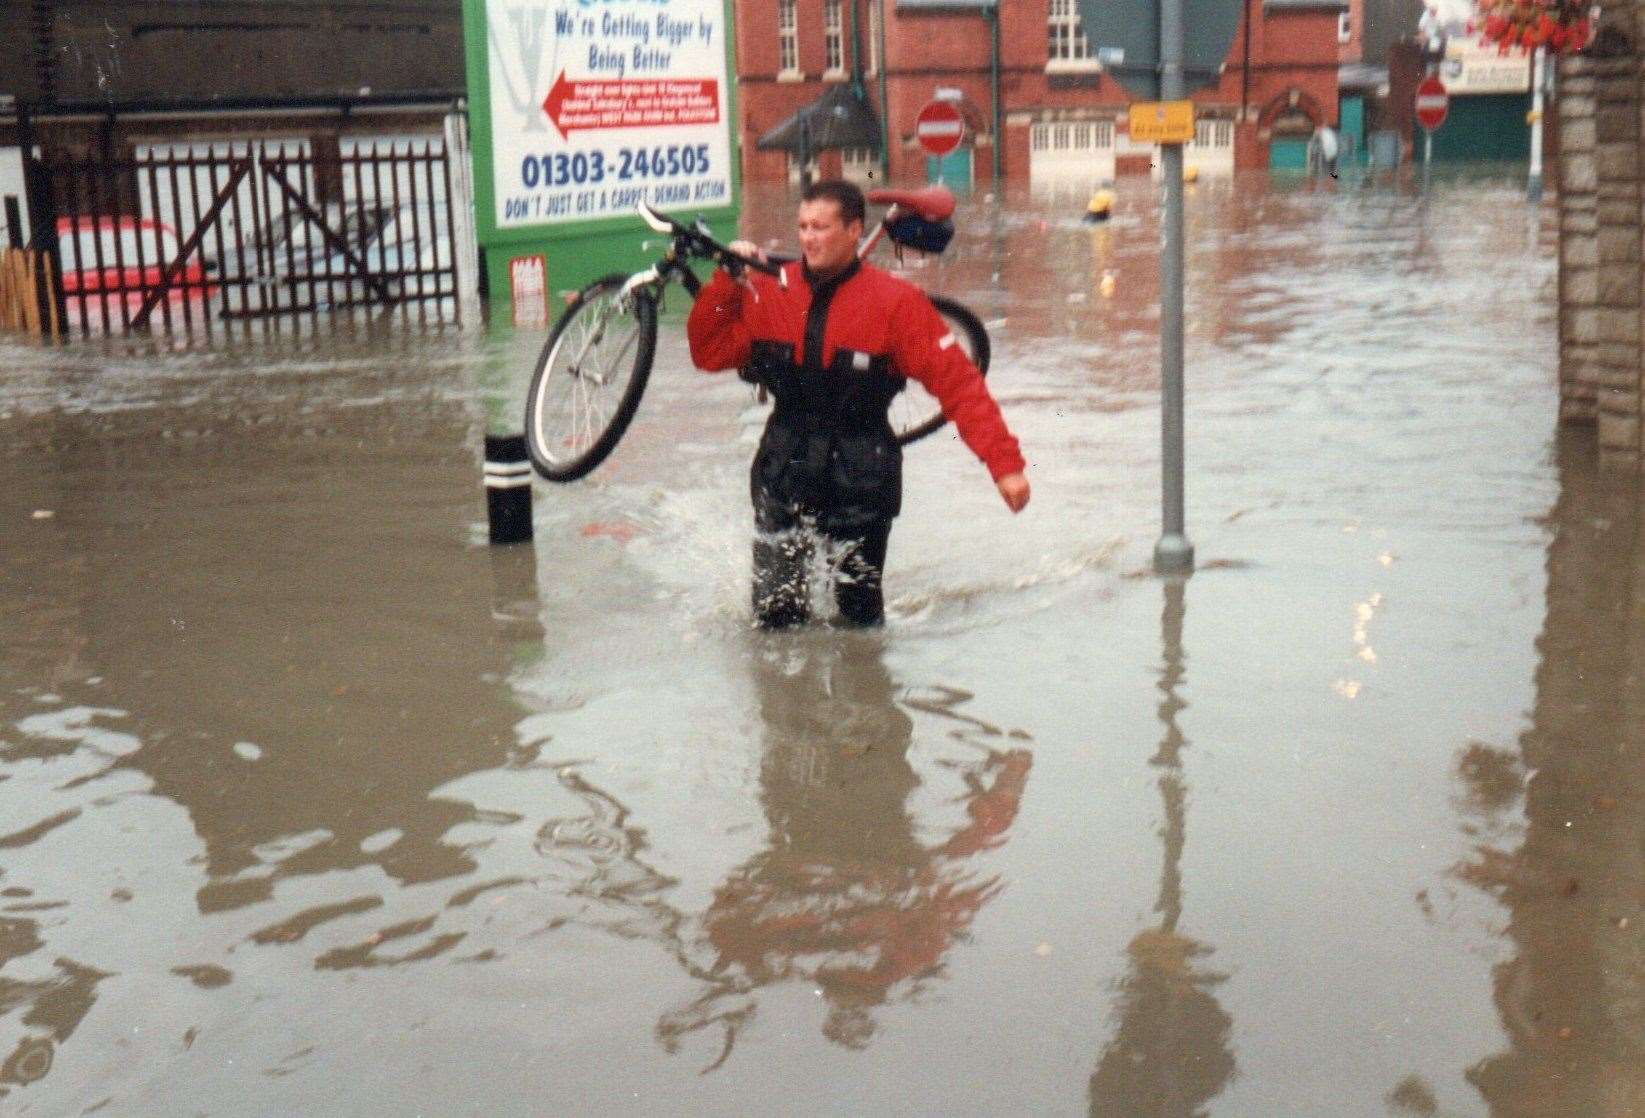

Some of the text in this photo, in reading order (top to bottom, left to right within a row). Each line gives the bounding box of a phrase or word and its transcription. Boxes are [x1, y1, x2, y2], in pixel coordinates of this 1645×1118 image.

[555, 10, 713, 46] We're Getting Bigger by
[589, 44, 672, 77] Being Better
[521, 143, 711, 189] 01303-246505
[505, 192, 542, 219] DON'T
[546, 190, 572, 216] JUST
[576, 190, 596, 213] GET
[600, 189, 607, 211] A
[655, 183, 691, 204] DEMAND
[694, 180, 725, 201] ACTION
